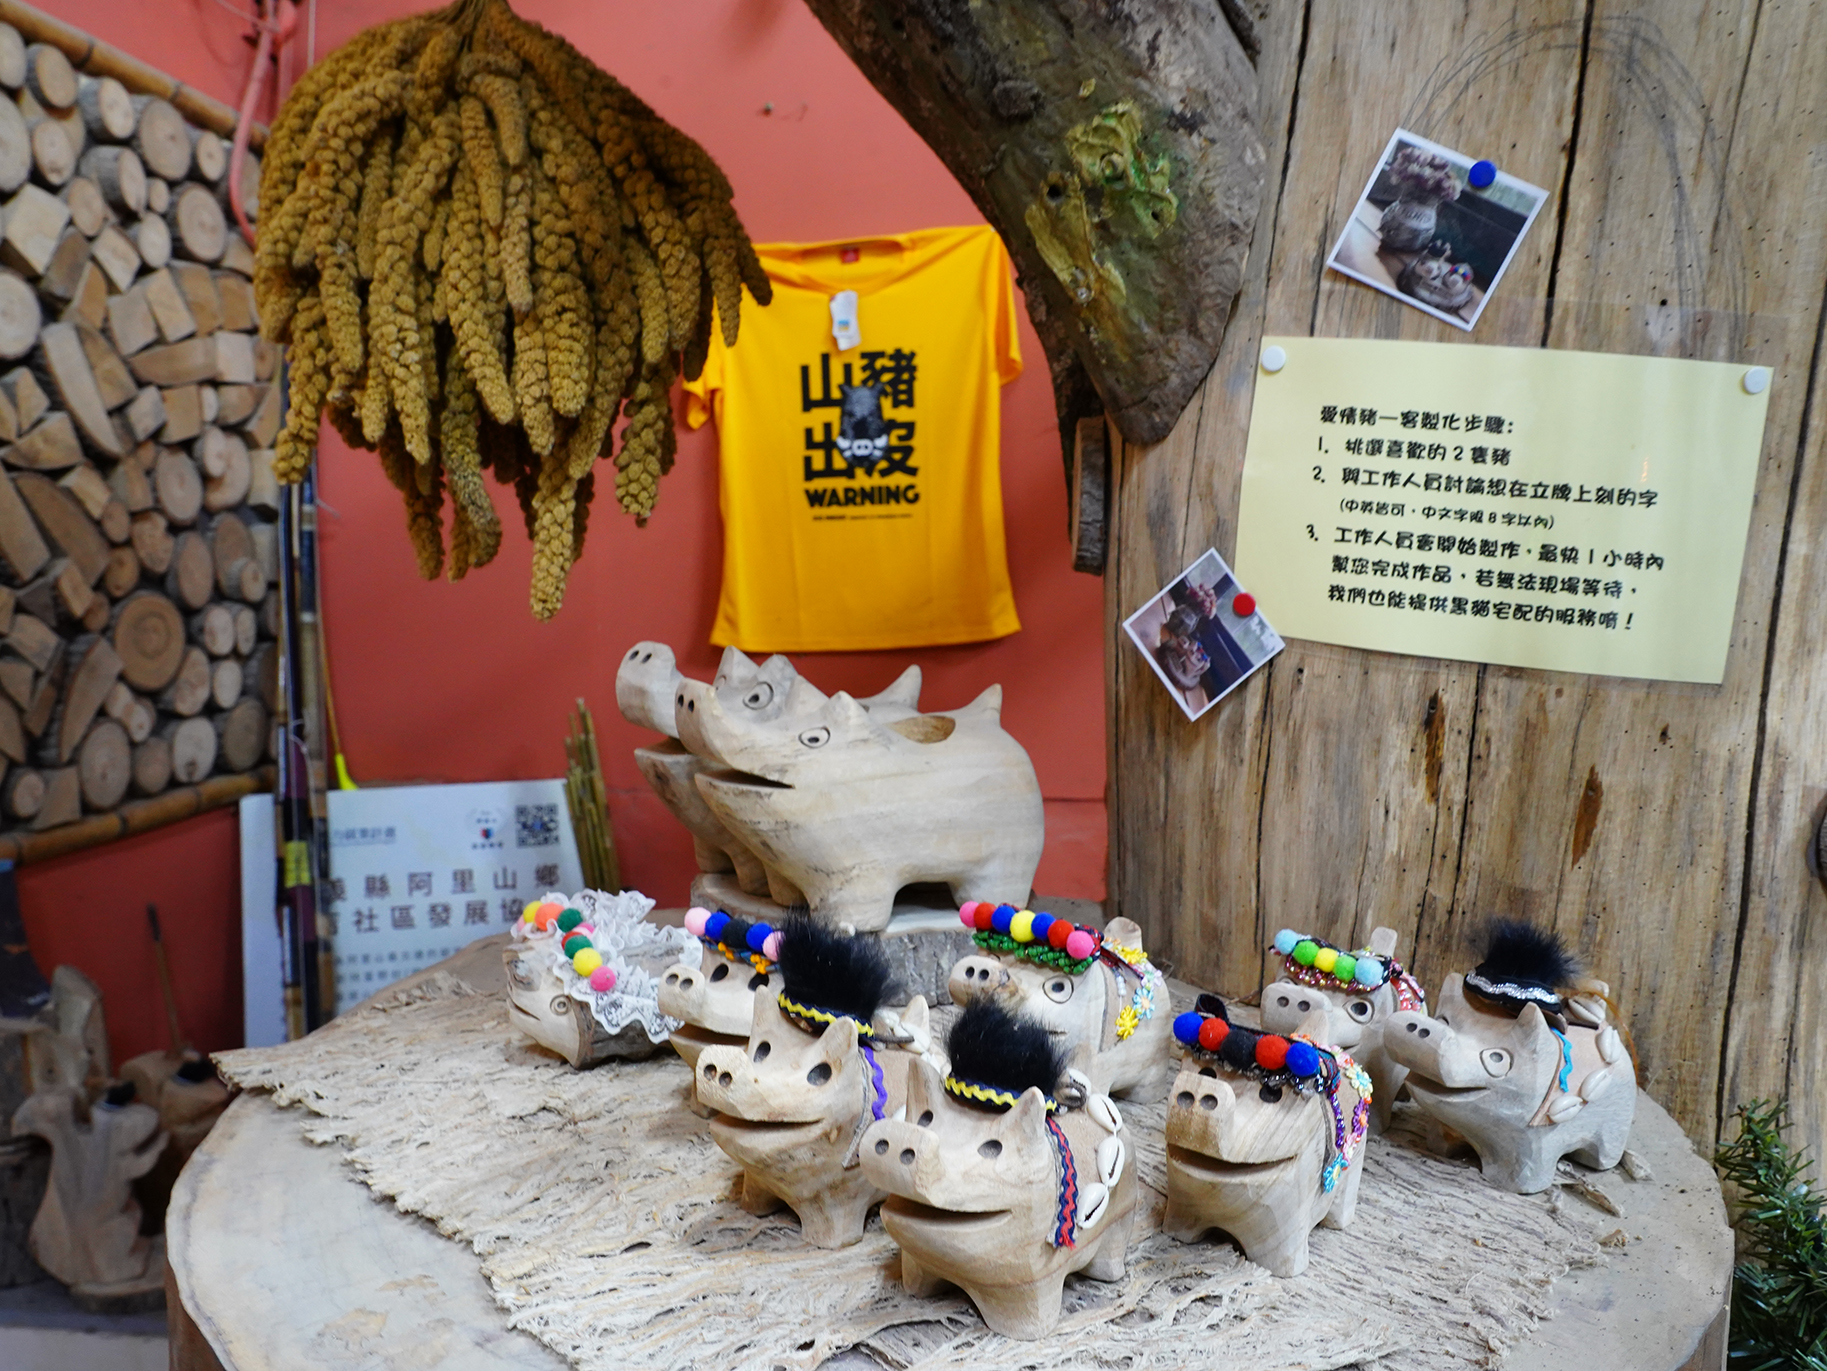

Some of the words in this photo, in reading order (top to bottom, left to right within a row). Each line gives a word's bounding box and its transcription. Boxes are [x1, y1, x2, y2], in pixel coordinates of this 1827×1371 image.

[1318, 436, 1329, 454] 1.
[1312, 465, 1325, 483] 2.
[804, 484, 920, 508] WARNING
[1306, 524, 1319, 542] 3.
